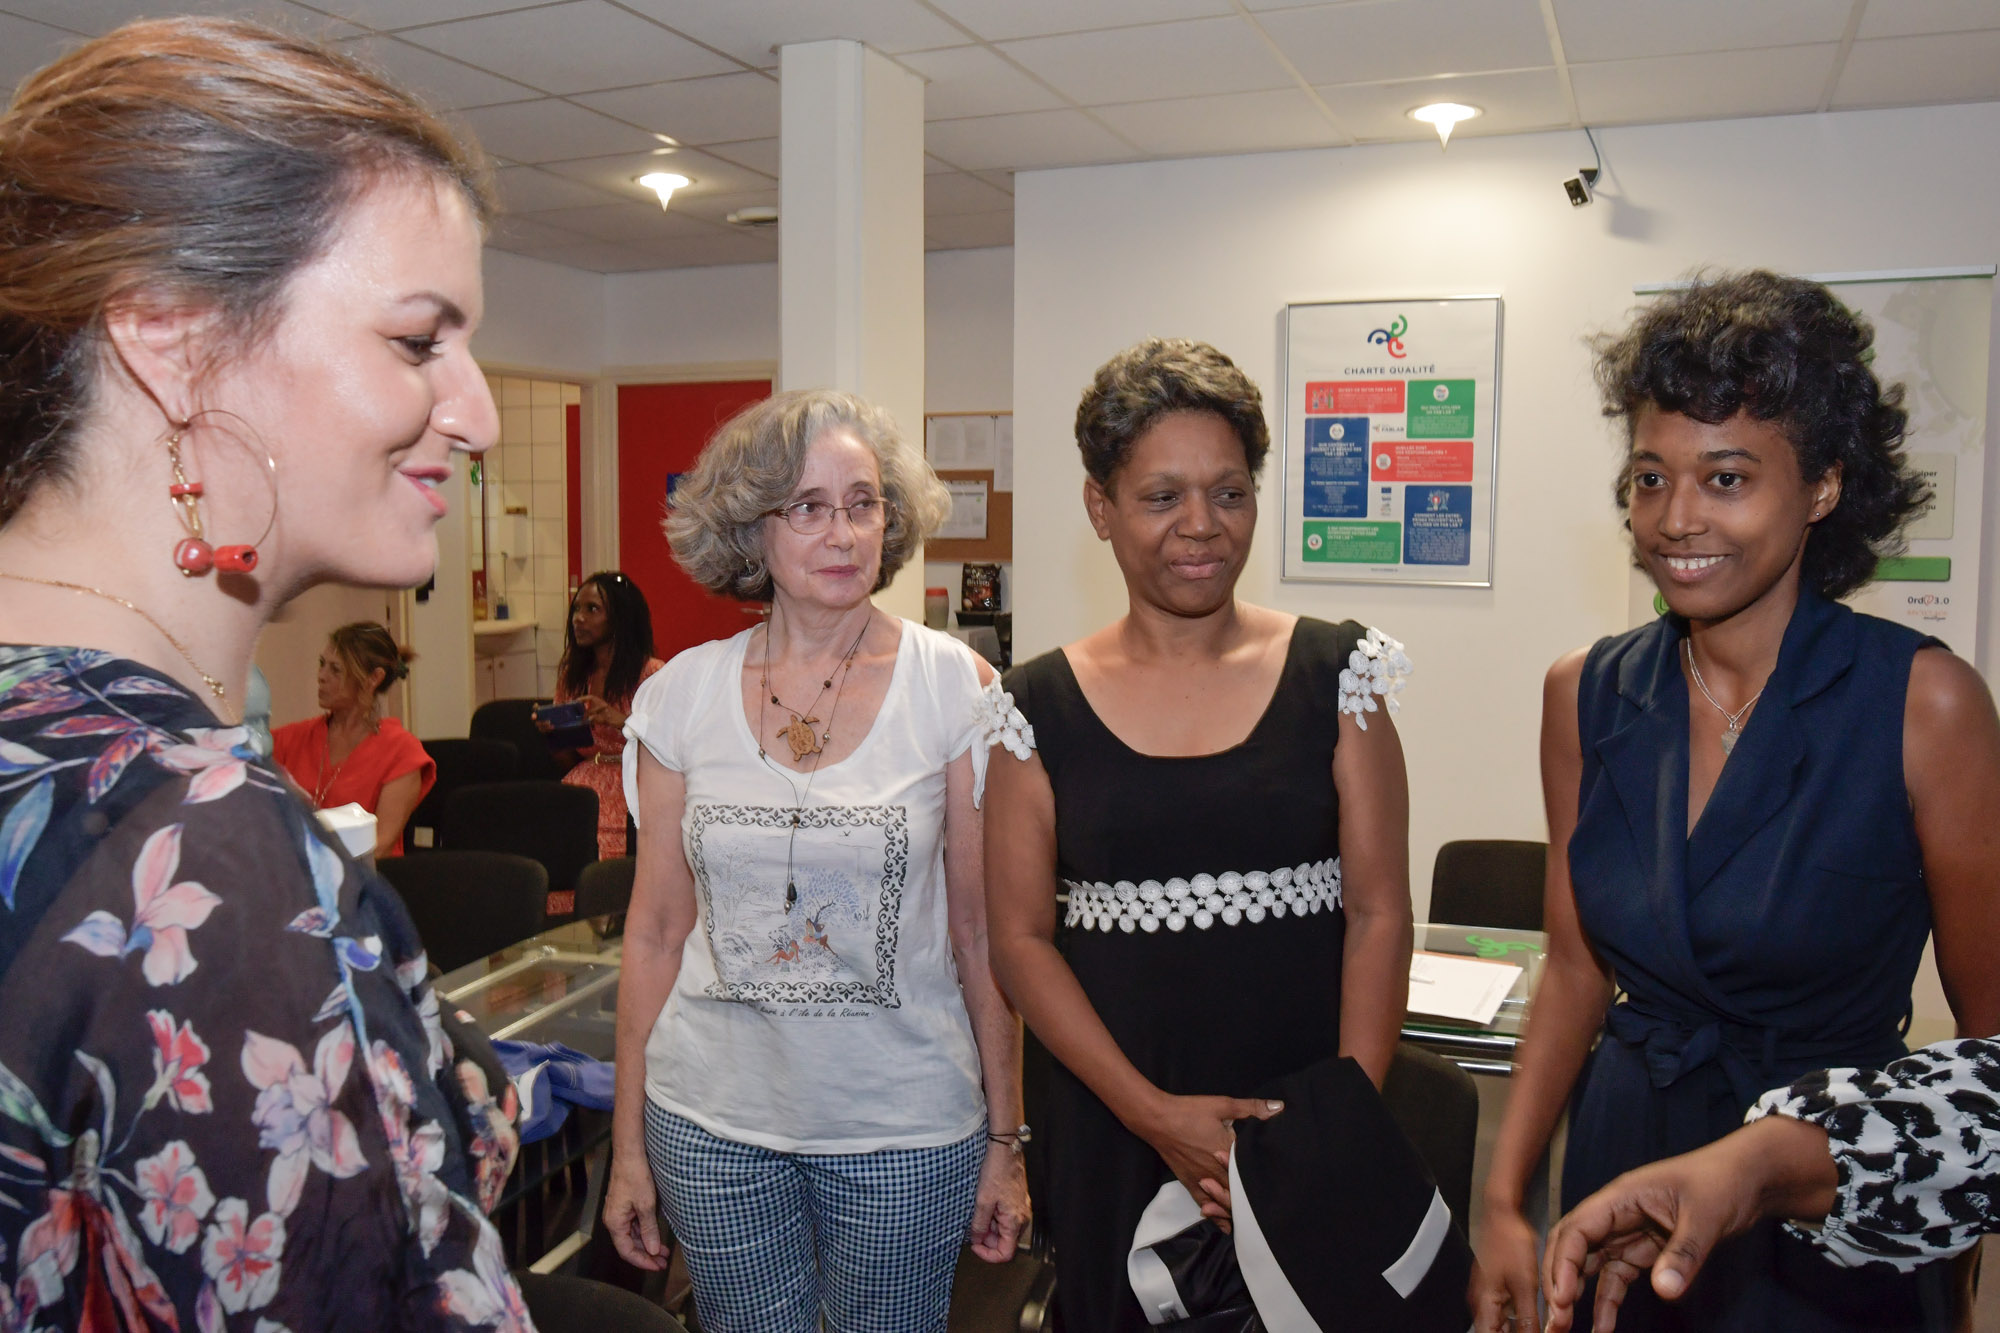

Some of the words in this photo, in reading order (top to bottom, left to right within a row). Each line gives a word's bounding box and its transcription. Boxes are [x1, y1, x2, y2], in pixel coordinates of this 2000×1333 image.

[1344, 367, 1385, 375] CHARTE
[1389, 364, 1435, 375] QUALITÉ
[813, 1008, 823, 1017] de
[827, 1008, 836, 1017] la
[839, 1007, 870, 1018] Réunion
